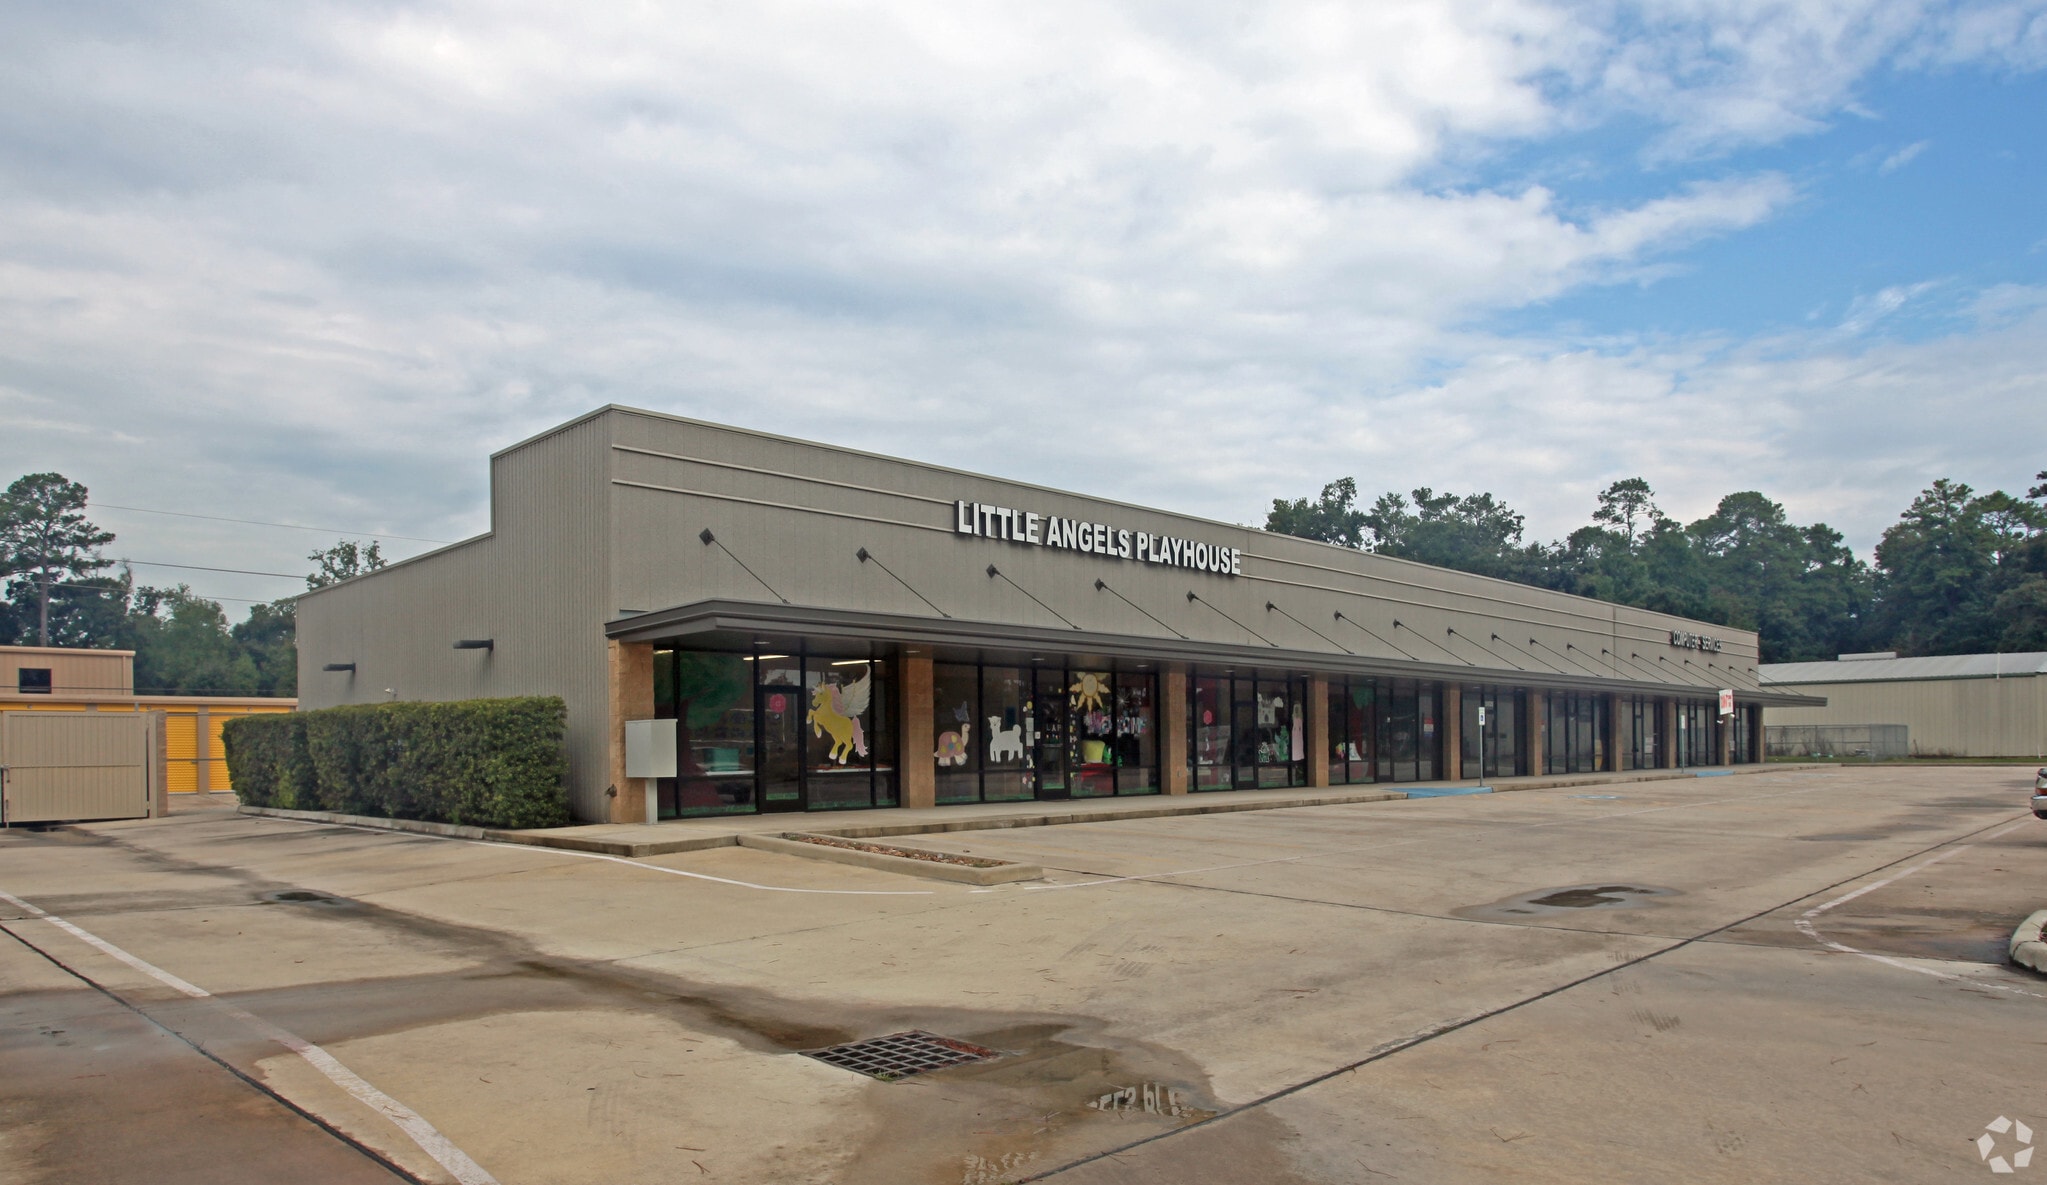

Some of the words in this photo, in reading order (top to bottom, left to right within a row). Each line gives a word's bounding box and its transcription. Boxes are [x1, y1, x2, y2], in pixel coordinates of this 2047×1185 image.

[957, 500, 1039, 544] LITTLE
[1046, 516, 1130, 558] ANGELS
[1136, 531, 1241, 575] PLAYHOUSE
[1673, 630, 1698, 649] COMPUTER
